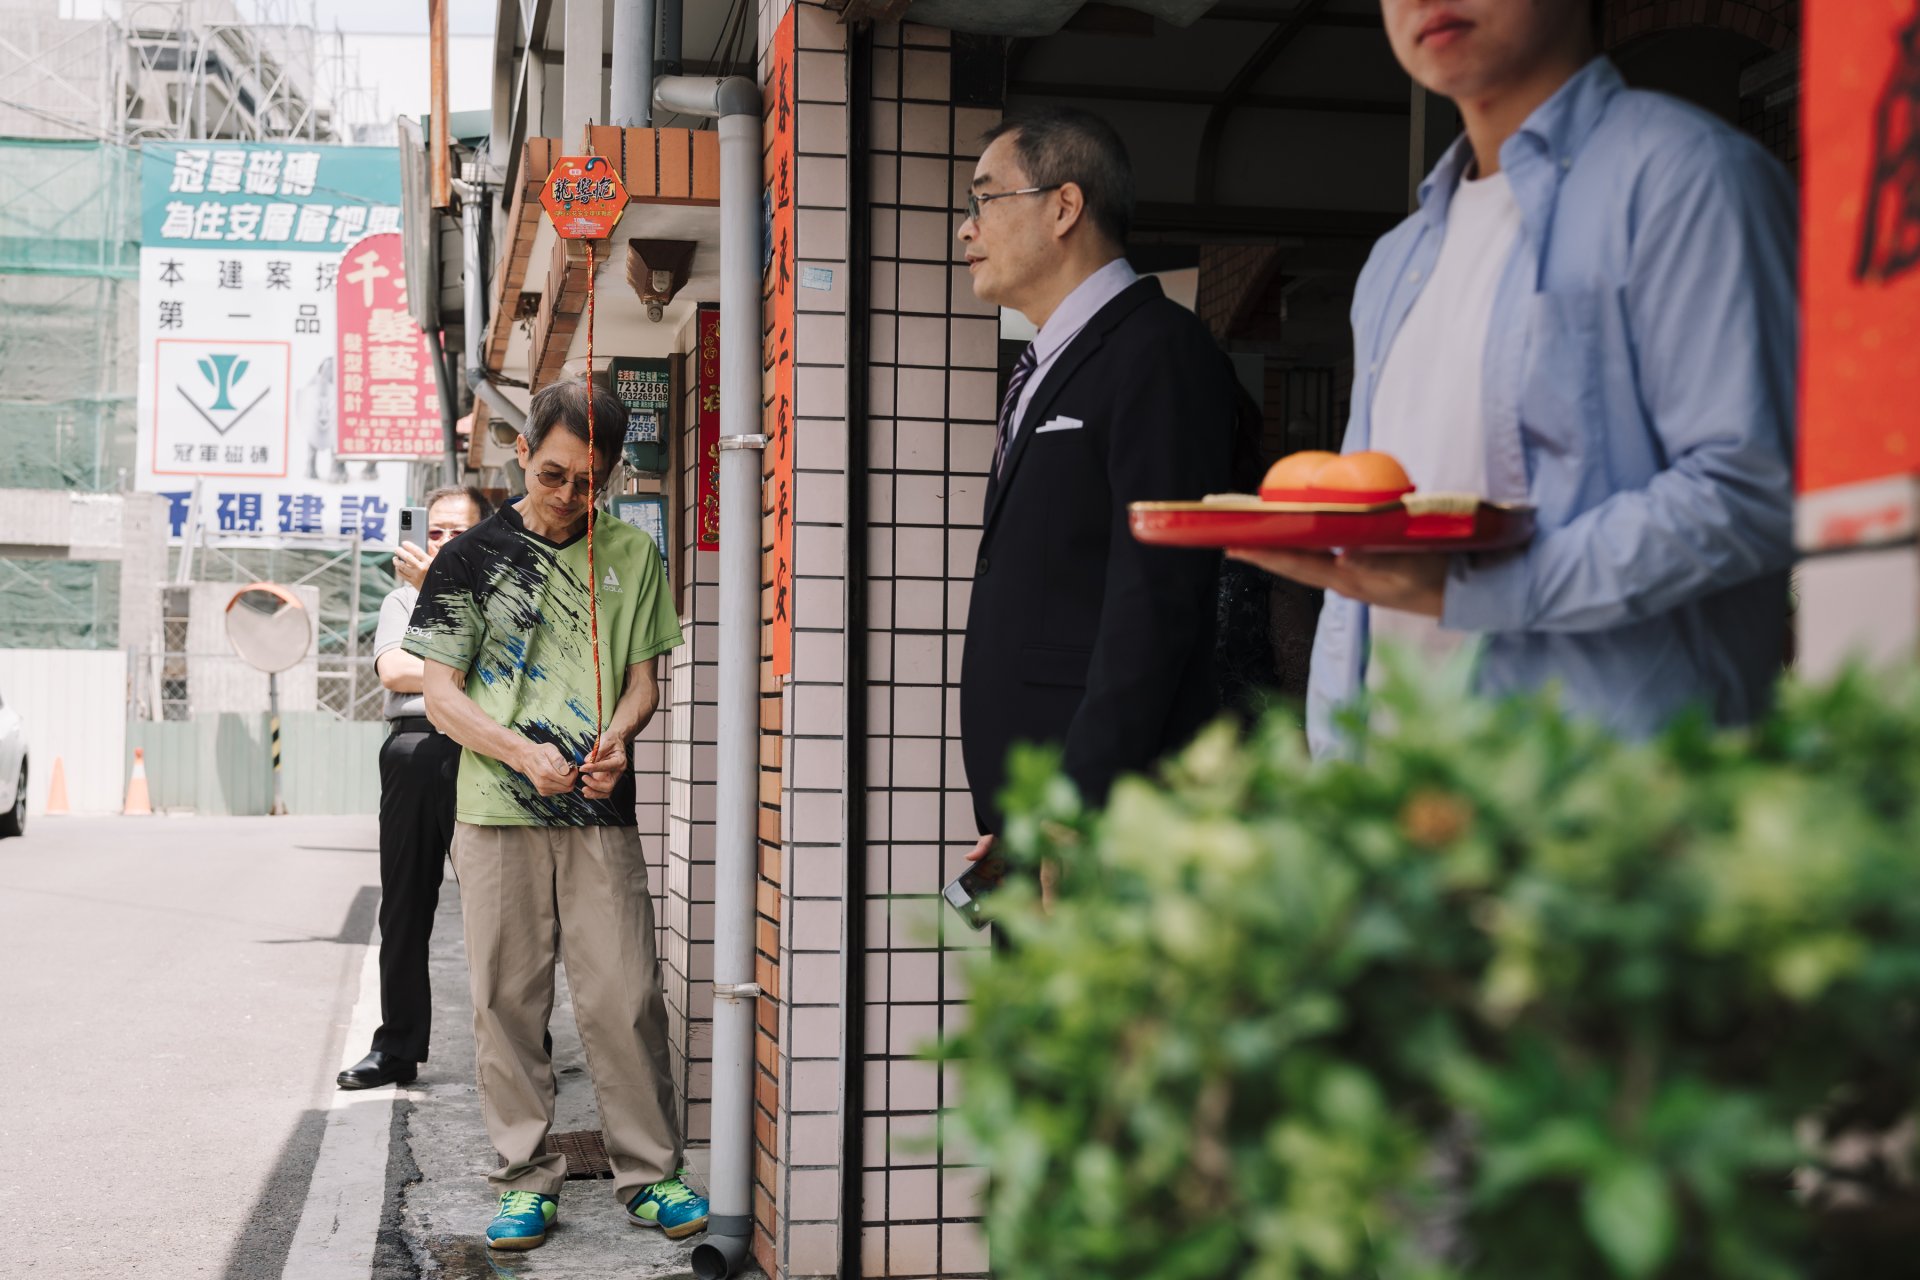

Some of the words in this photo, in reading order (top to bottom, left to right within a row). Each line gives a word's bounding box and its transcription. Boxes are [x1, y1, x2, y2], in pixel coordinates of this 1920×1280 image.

[168, 150, 321, 196] 冠軍磁磚
[159, 300, 321, 335] 第一品
[617, 392, 668, 402] 0932265188
[618, 382, 668, 394] 7232866
[174, 444, 269, 464] 冠軍磁磚
